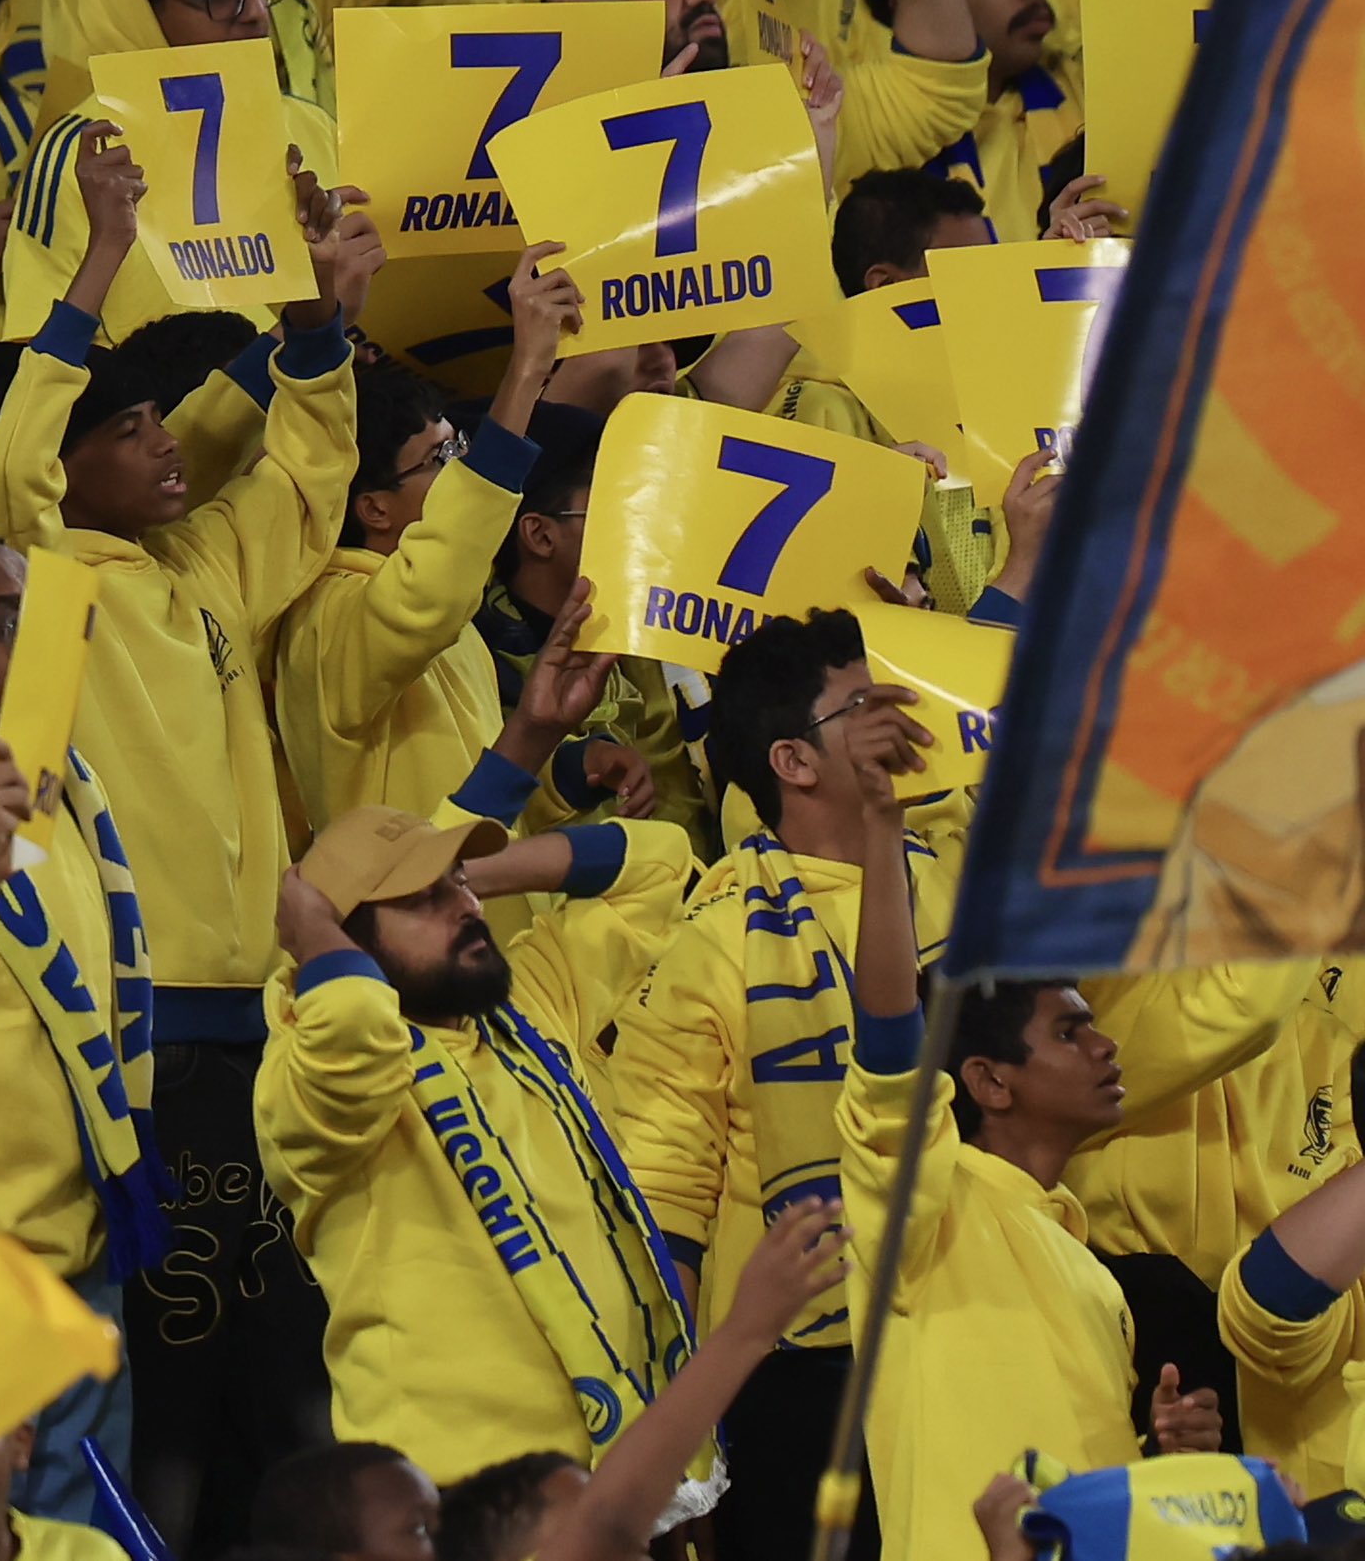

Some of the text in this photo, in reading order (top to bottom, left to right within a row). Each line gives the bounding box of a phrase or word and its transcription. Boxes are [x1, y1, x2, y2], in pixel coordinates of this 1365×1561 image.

[162, 75, 226, 226] 7
[453, 34, 561, 179] 7
[602, 103, 712, 258] 7
[171, 234, 276, 281] RONALDO
[601, 256, 772, 321] RONALDO
[720, 438, 836, 595] 7
[646, 586, 769, 646] RONA
